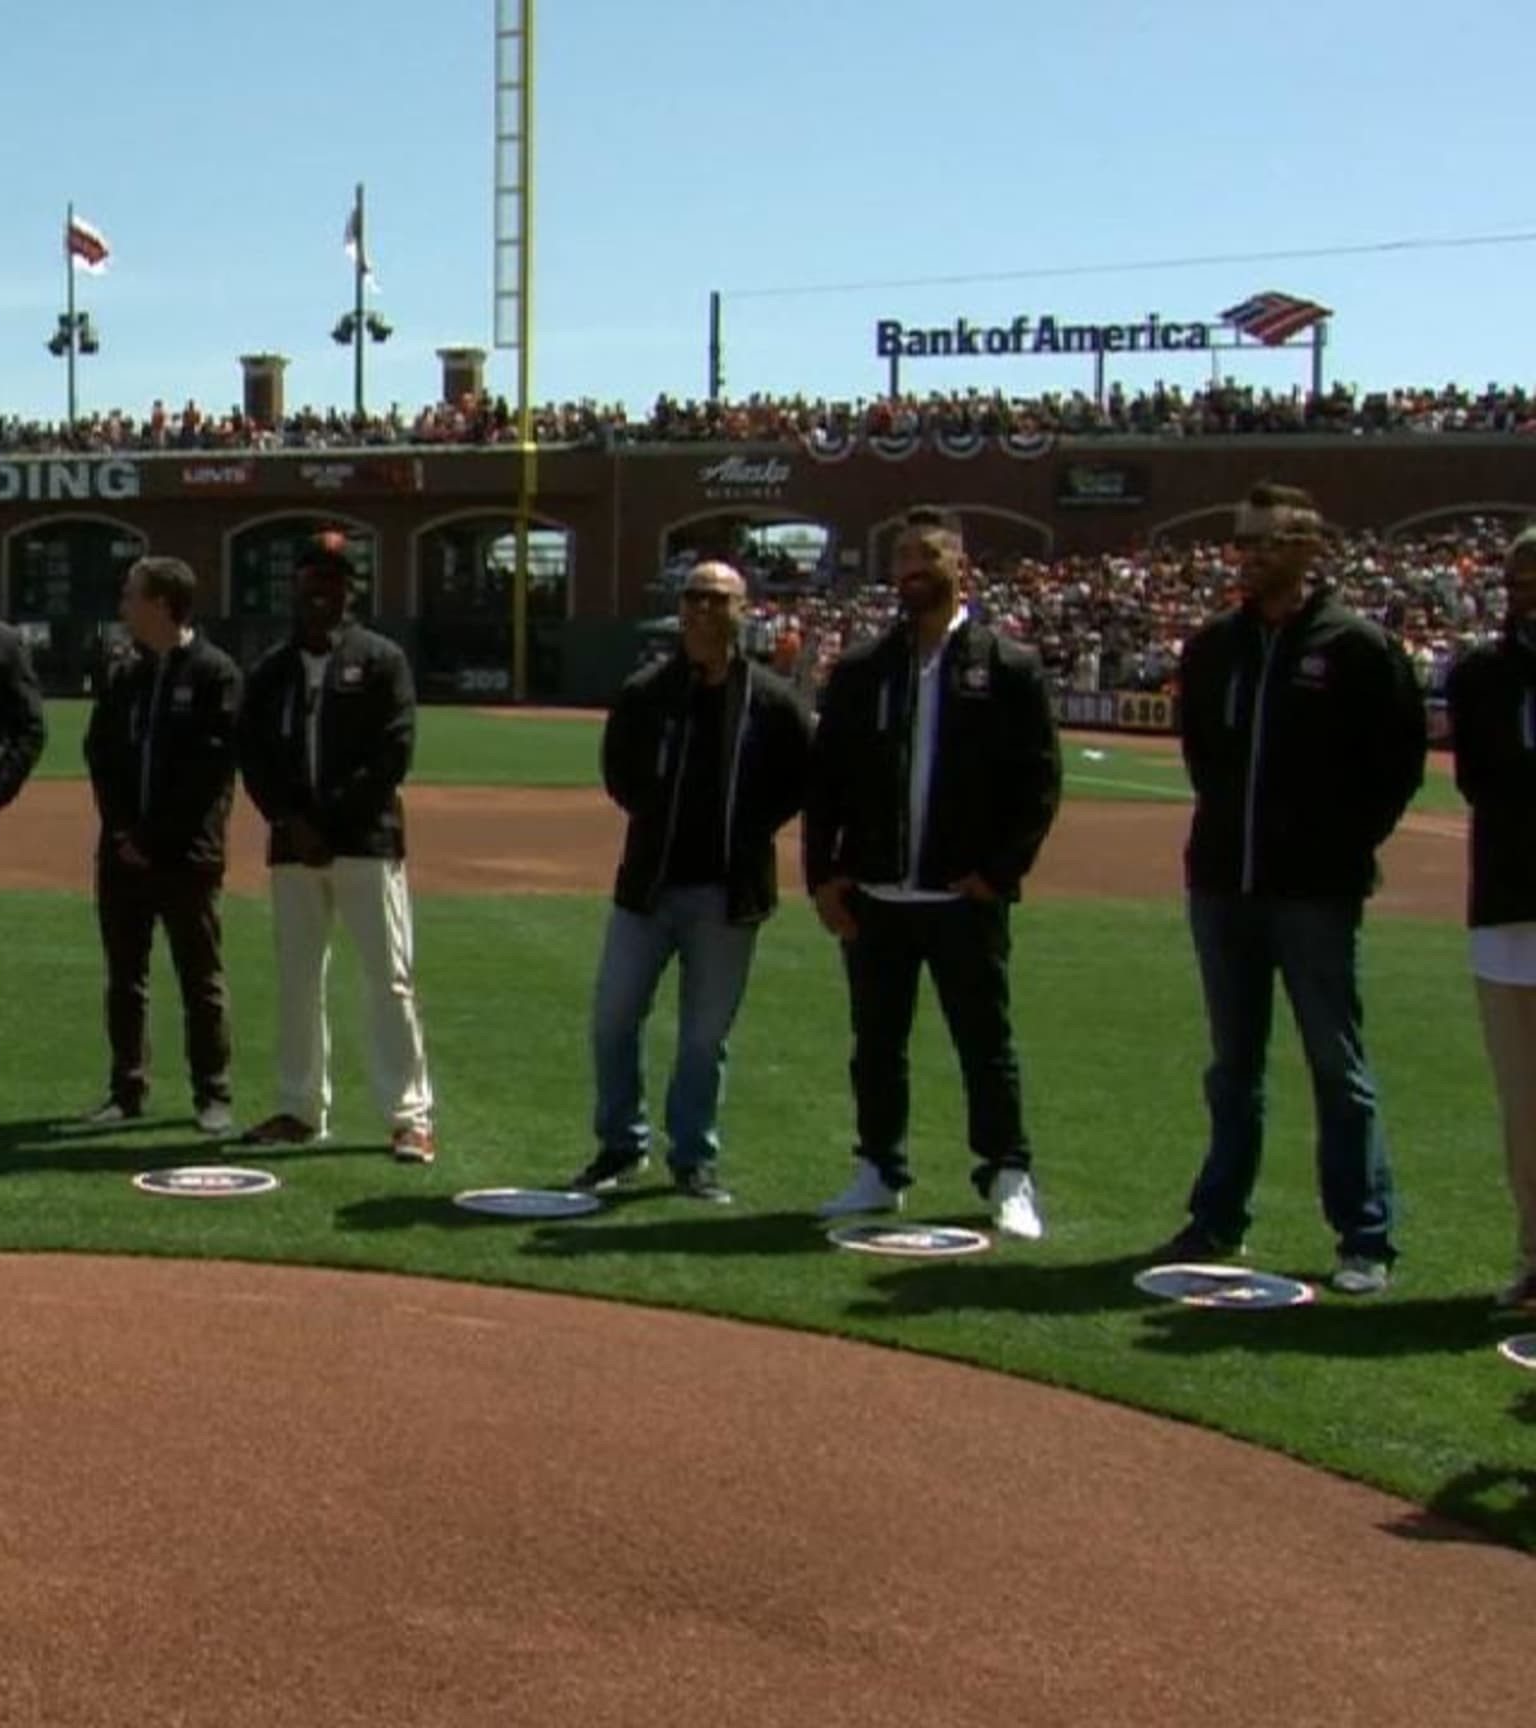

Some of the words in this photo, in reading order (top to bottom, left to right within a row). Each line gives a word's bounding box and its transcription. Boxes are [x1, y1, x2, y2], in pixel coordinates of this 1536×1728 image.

[876, 317, 982, 357] Bank
[983, 315, 1028, 354] of
[1032, 312, 1210, 352] America
